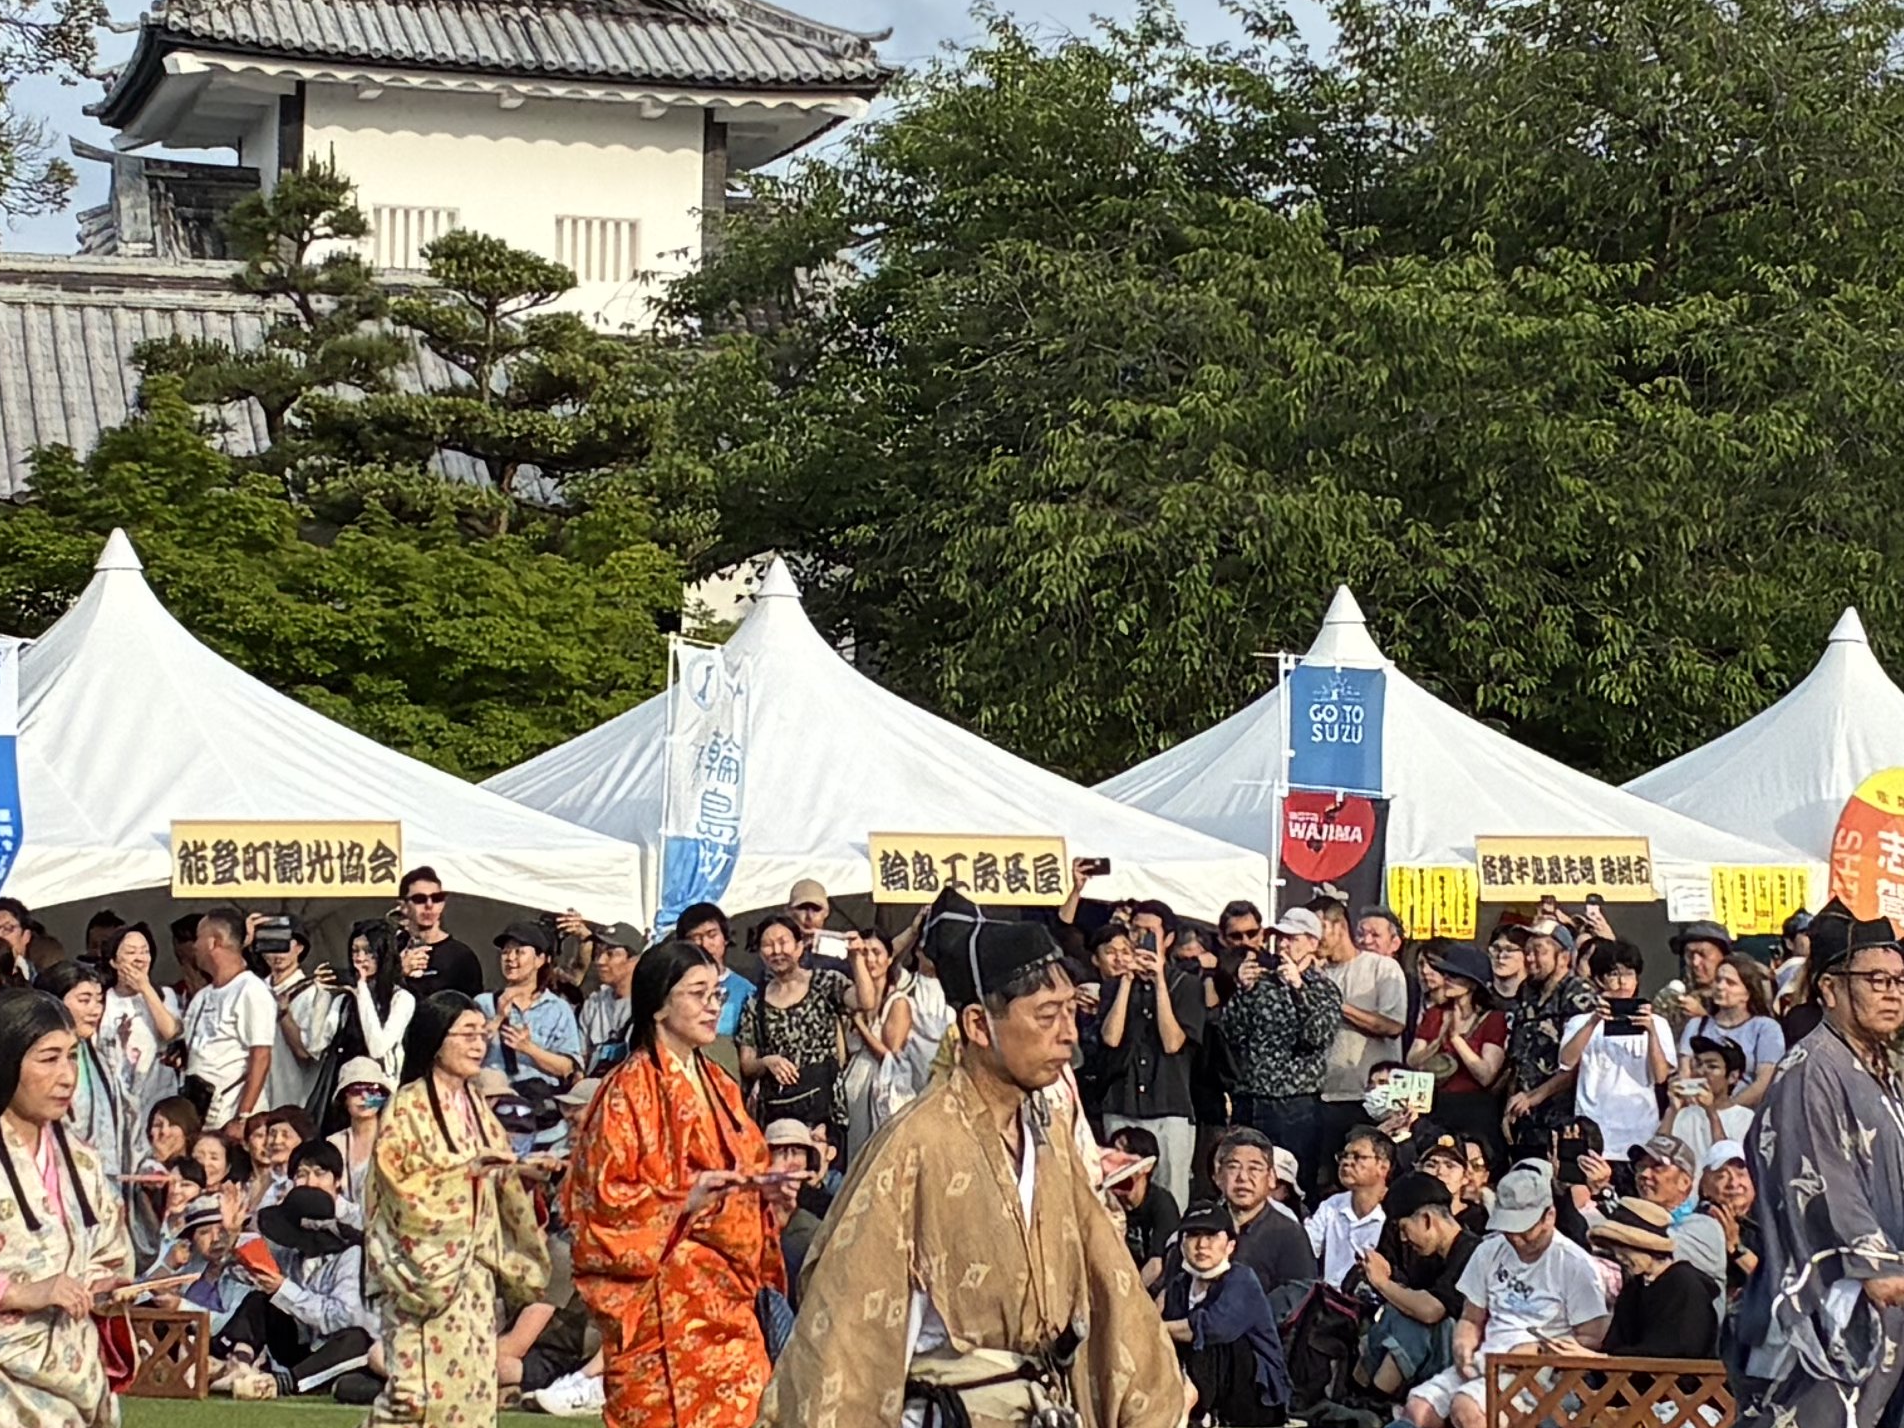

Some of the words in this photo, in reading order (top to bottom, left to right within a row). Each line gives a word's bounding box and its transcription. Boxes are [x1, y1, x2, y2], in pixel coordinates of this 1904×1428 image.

[1309, 703, 1339, 723] GO
[1343, 704, 1365, 723] TO
[1310, 723, 1363, 744] SUZU
[1288, 822, 1363, 844] WAJIMA
[178, 839, 398, 886] 能登町観光協会
[879, 849, 1064, 895] 輪島工房長屋
